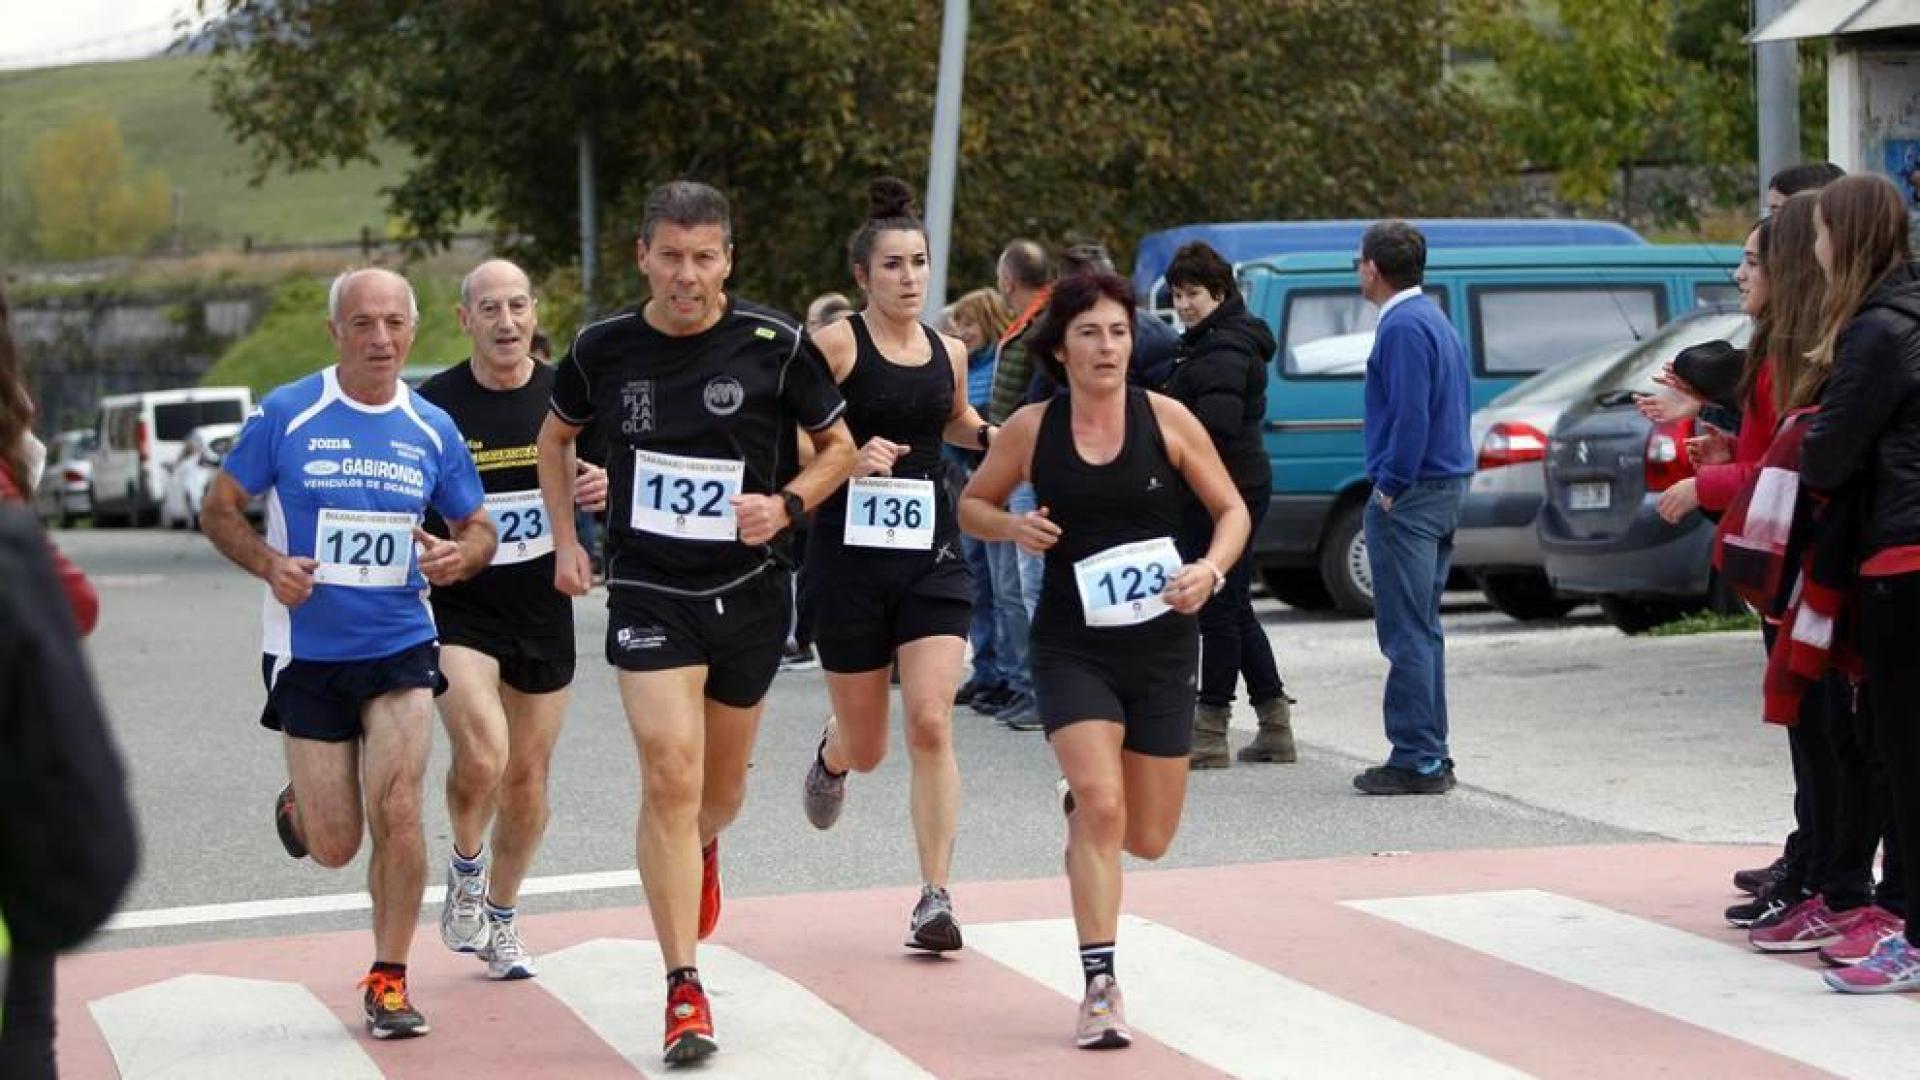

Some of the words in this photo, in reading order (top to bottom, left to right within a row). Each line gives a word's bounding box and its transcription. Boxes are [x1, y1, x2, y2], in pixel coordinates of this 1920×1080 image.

[624, 394, 650, 408] PLA
[622, 419, 652, 433] OLA
[366, 480, 380, 490] DE
[647, 473, 725, 517] 132
[500, 508, 543, 543] 23
[862, 496, 922, 529] 136
[327, 529, 395, 567] 120
[1099, 562, 1167, 605] 123
